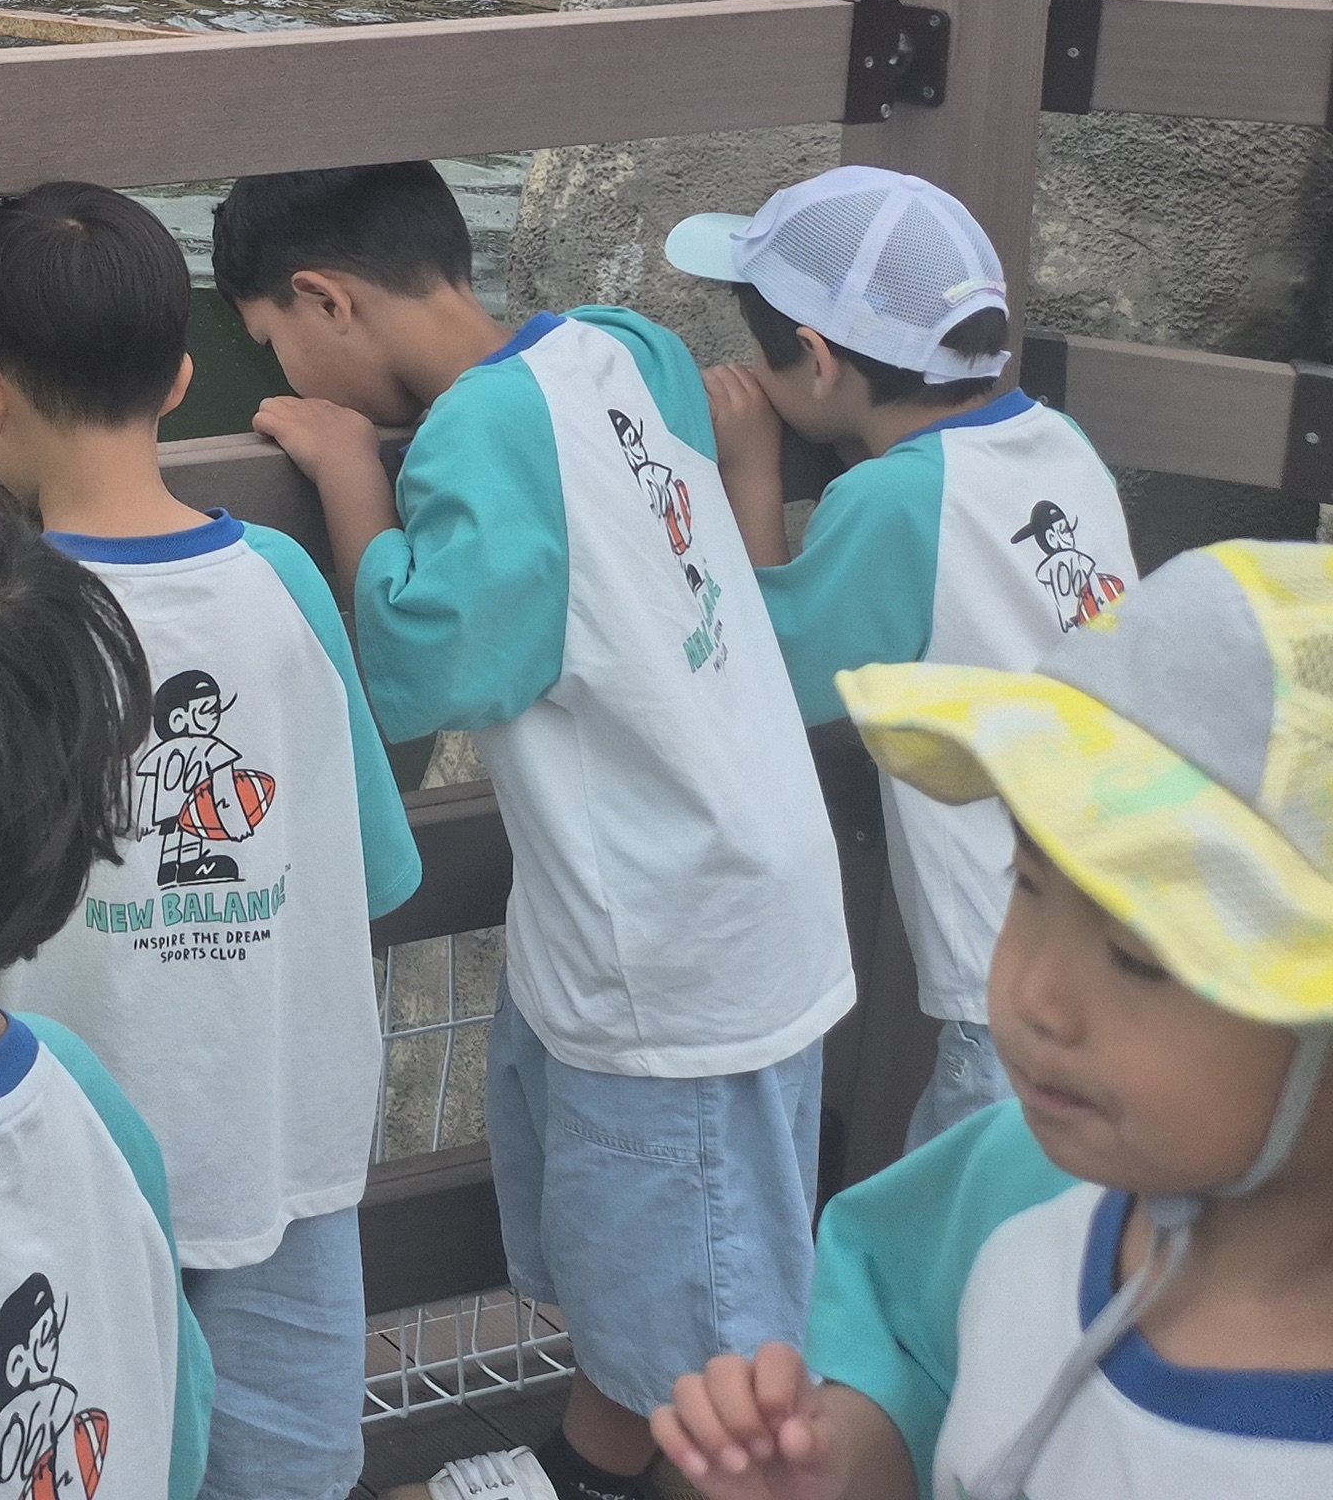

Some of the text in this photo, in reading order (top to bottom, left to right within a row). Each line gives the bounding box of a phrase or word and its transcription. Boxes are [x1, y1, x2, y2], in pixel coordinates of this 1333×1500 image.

[86, 897, 155, 933] NEW
[134, 929, 271, 950] INSPIRE THE DREAM
[160, 947, 246, 963] SPORTS CLUB
